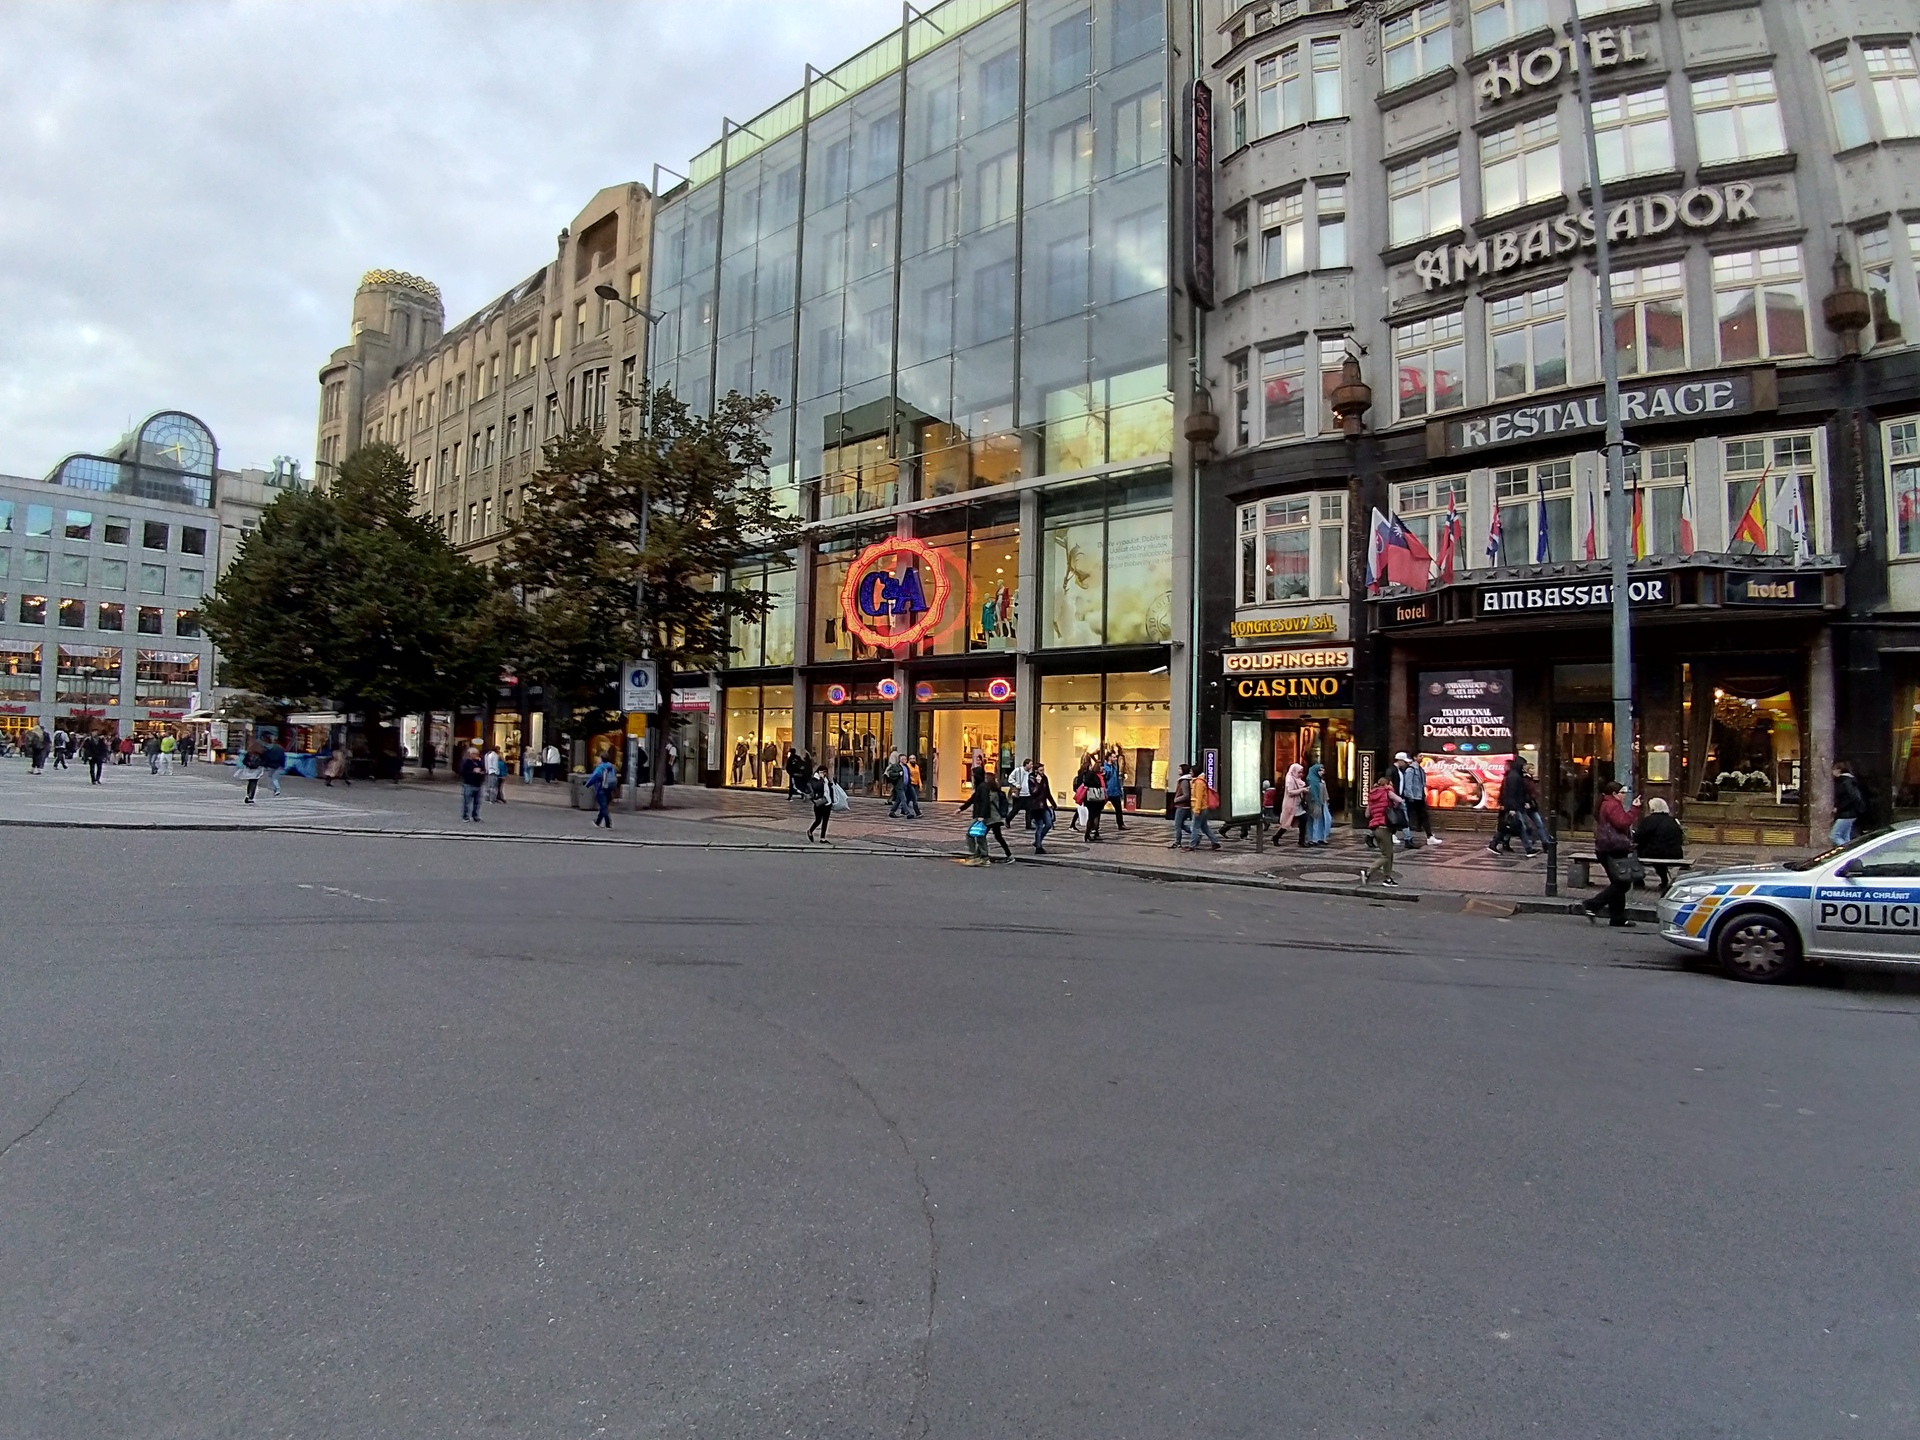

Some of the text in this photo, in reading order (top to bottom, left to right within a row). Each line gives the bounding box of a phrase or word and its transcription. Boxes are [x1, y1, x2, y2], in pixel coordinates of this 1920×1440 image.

[1478, 24, 1649, 100] HOTEL
[1413, 180, 1761, 291] AMBASSADOR
[1461, 380, 1735, 448] RESTAURACE
[859, 567, 929, 616] C&A
[1483, 580, 1664, 611] AMBASSAOR
[1746, 579, 1796, 598] hotel
[1312, 612, 1336, 630] SÁL
[1396, 603, 1426, 621] hotel
[1227, 651, 1349, 670] GOLDFINGERS
[1238, 677, 1339, 697] CASINO
[1429, 716, 1505, 725] CZECH RESTAURANT
[1441, 708, 1492, 717] TRADITIONAL
[1821, 889, 1862, 898] POMÁHAT
